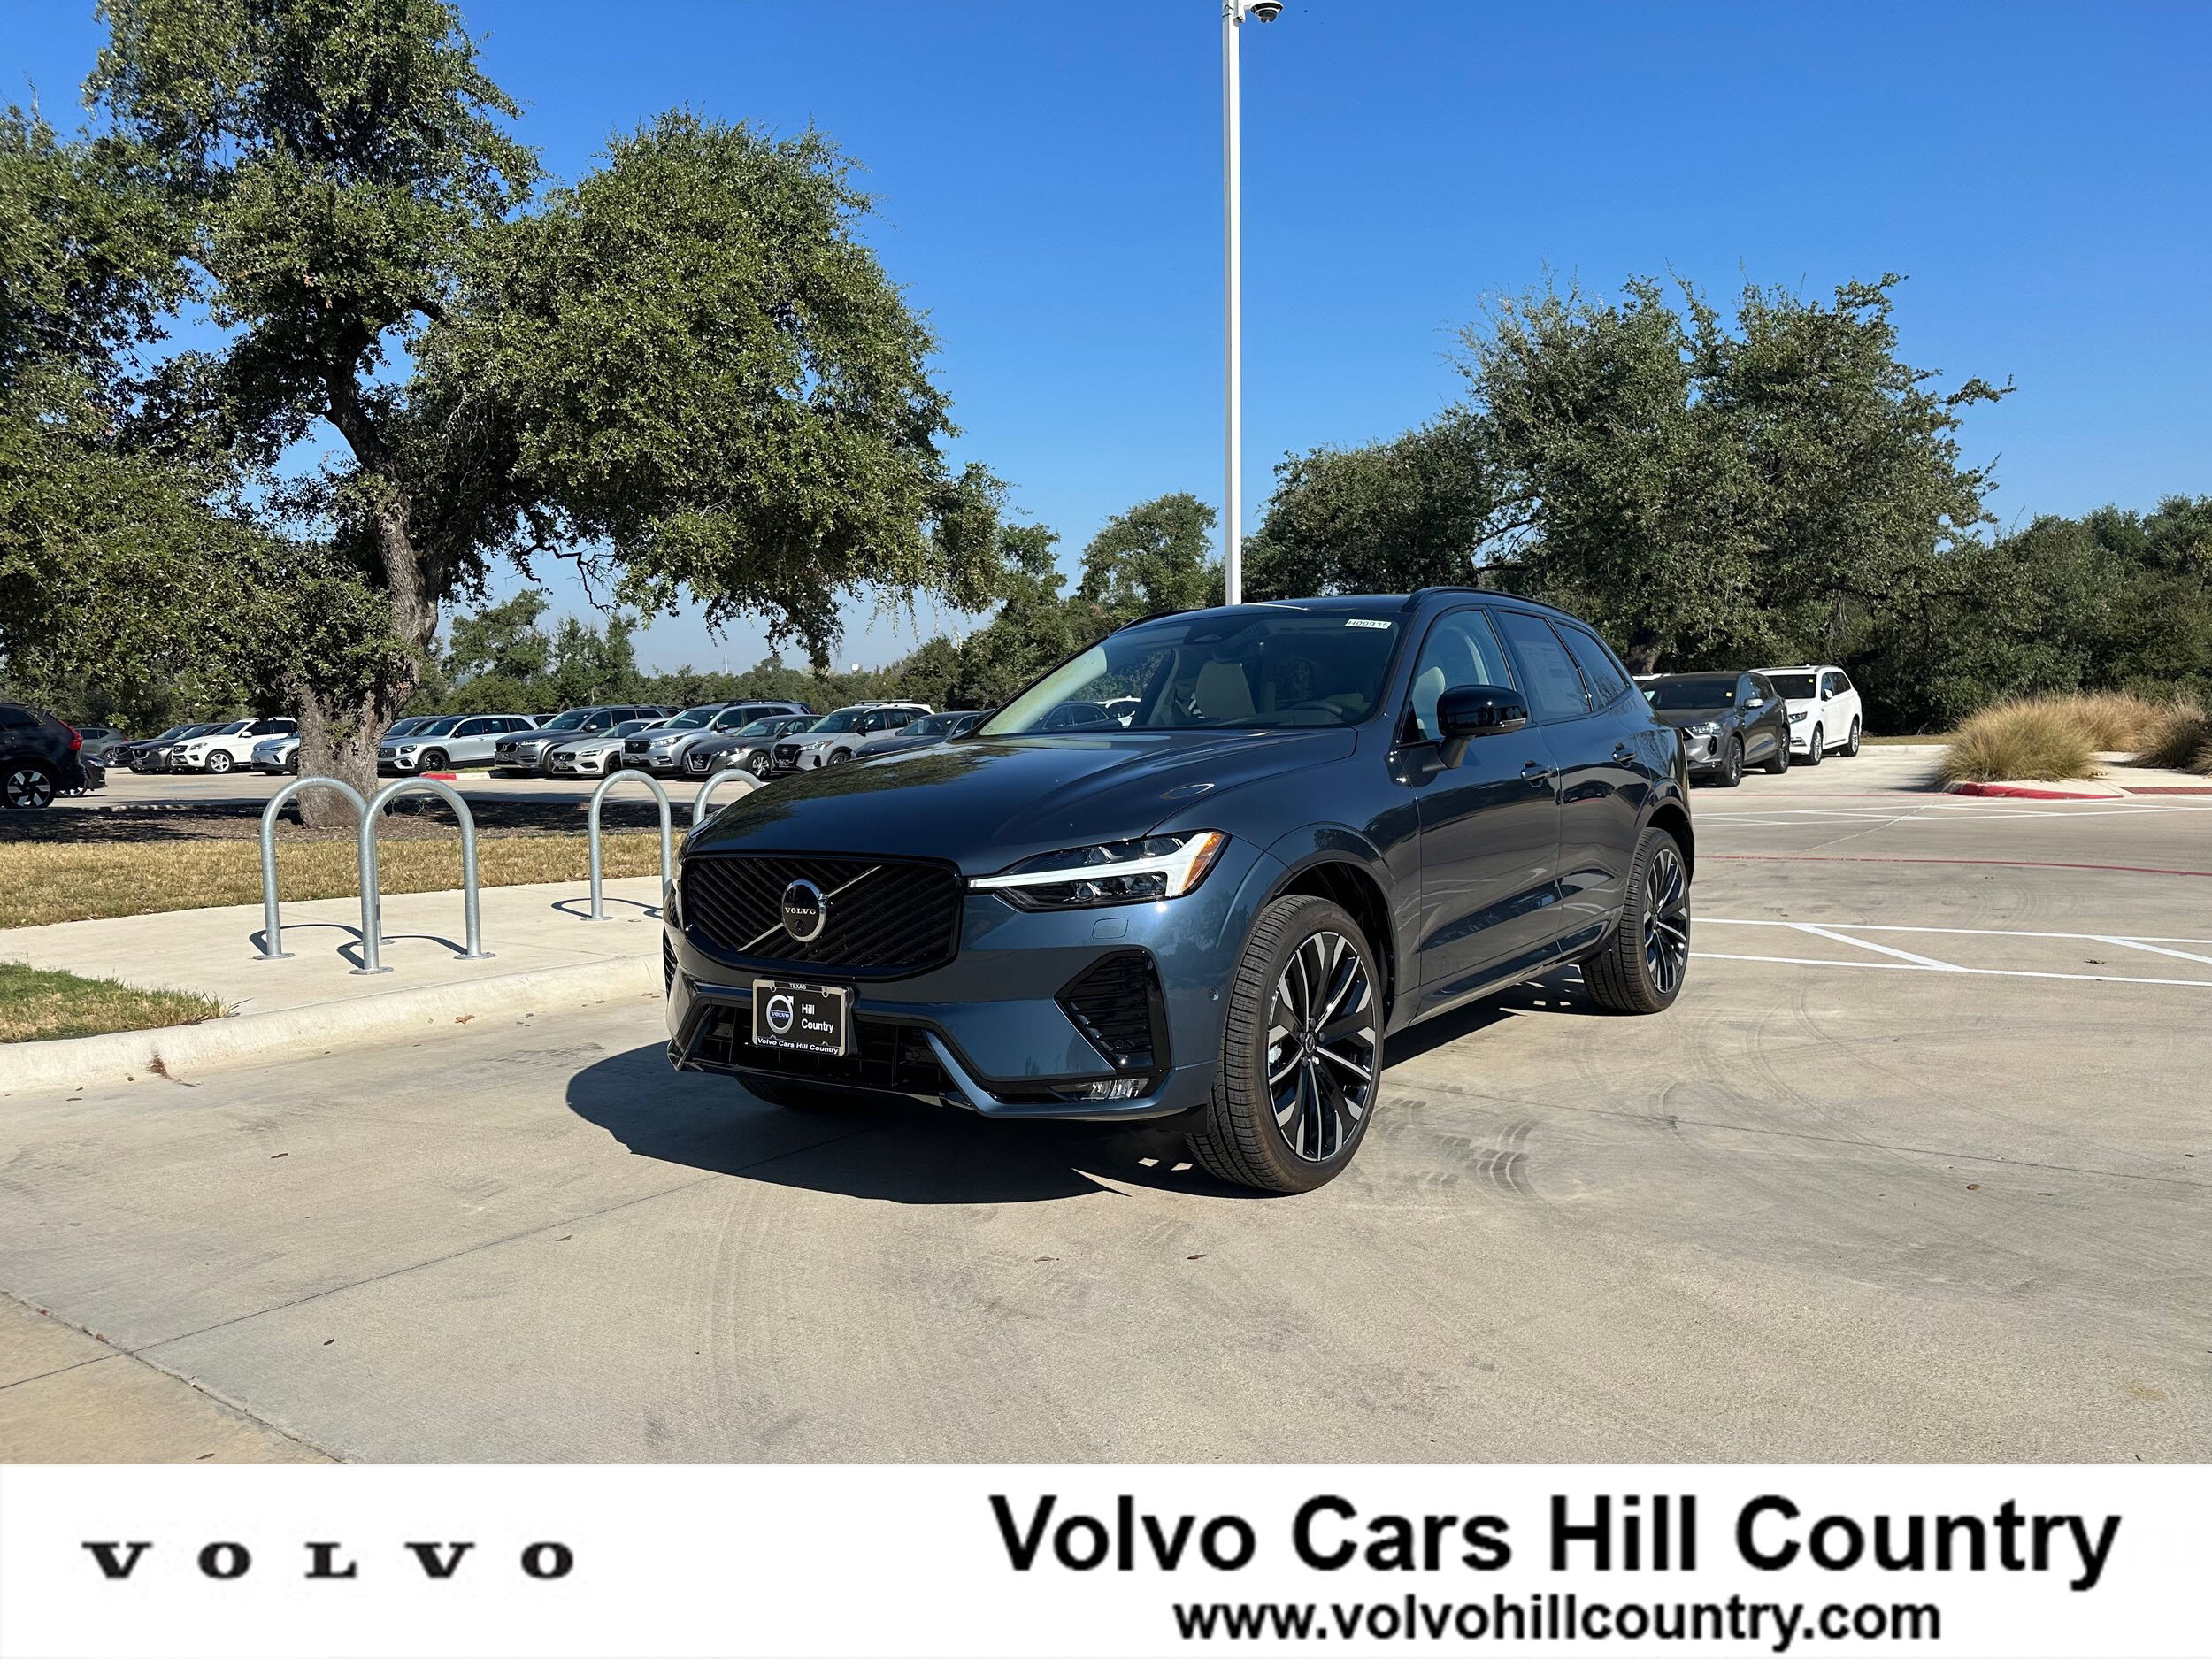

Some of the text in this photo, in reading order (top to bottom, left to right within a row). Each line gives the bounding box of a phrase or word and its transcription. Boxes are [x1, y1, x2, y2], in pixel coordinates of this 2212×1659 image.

[784, 906, 817, 915] VOLVO
[801, 1003, 815, 1015] Hill
[801, 1018, 833, 1033] Country
[757, 1037, 778, 1046] Volvo
[796, 1041, 809, 1050] Hill
[810, 1044, 839, 1055] Country
